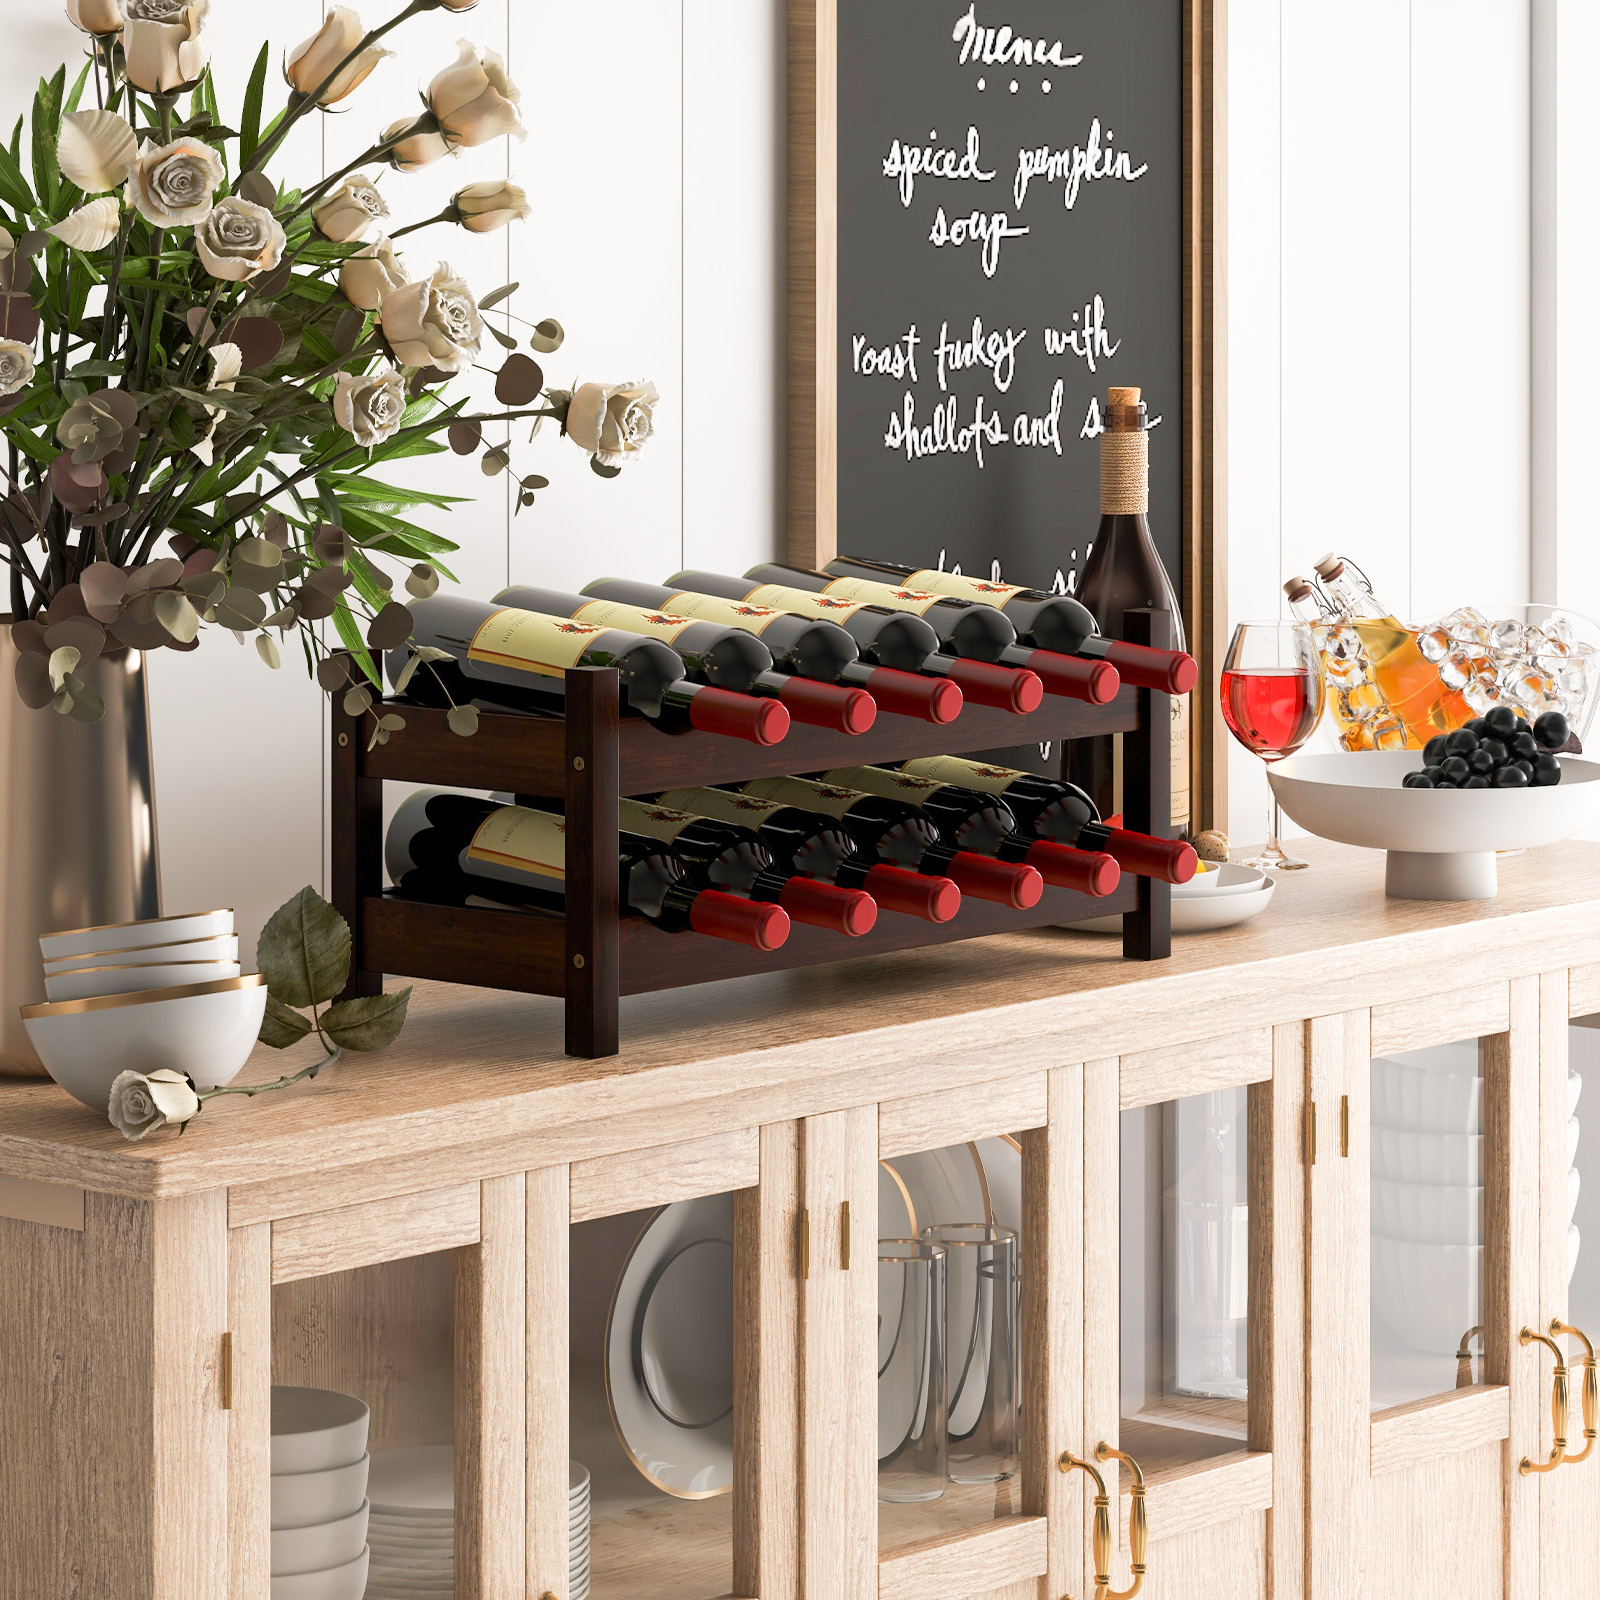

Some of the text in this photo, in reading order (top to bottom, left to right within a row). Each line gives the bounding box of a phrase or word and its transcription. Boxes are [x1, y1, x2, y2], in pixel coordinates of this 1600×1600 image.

[952, 3, 1083, 66] Menu
[883, 118, 1148, 209] spiced pumpkin
[929, 207, 1029, 277] soup
[852, 294, 1121, 392] roast turkey with
[884, 391, 1008, 467] shallots
[1014, 379, 1064, 455] and
